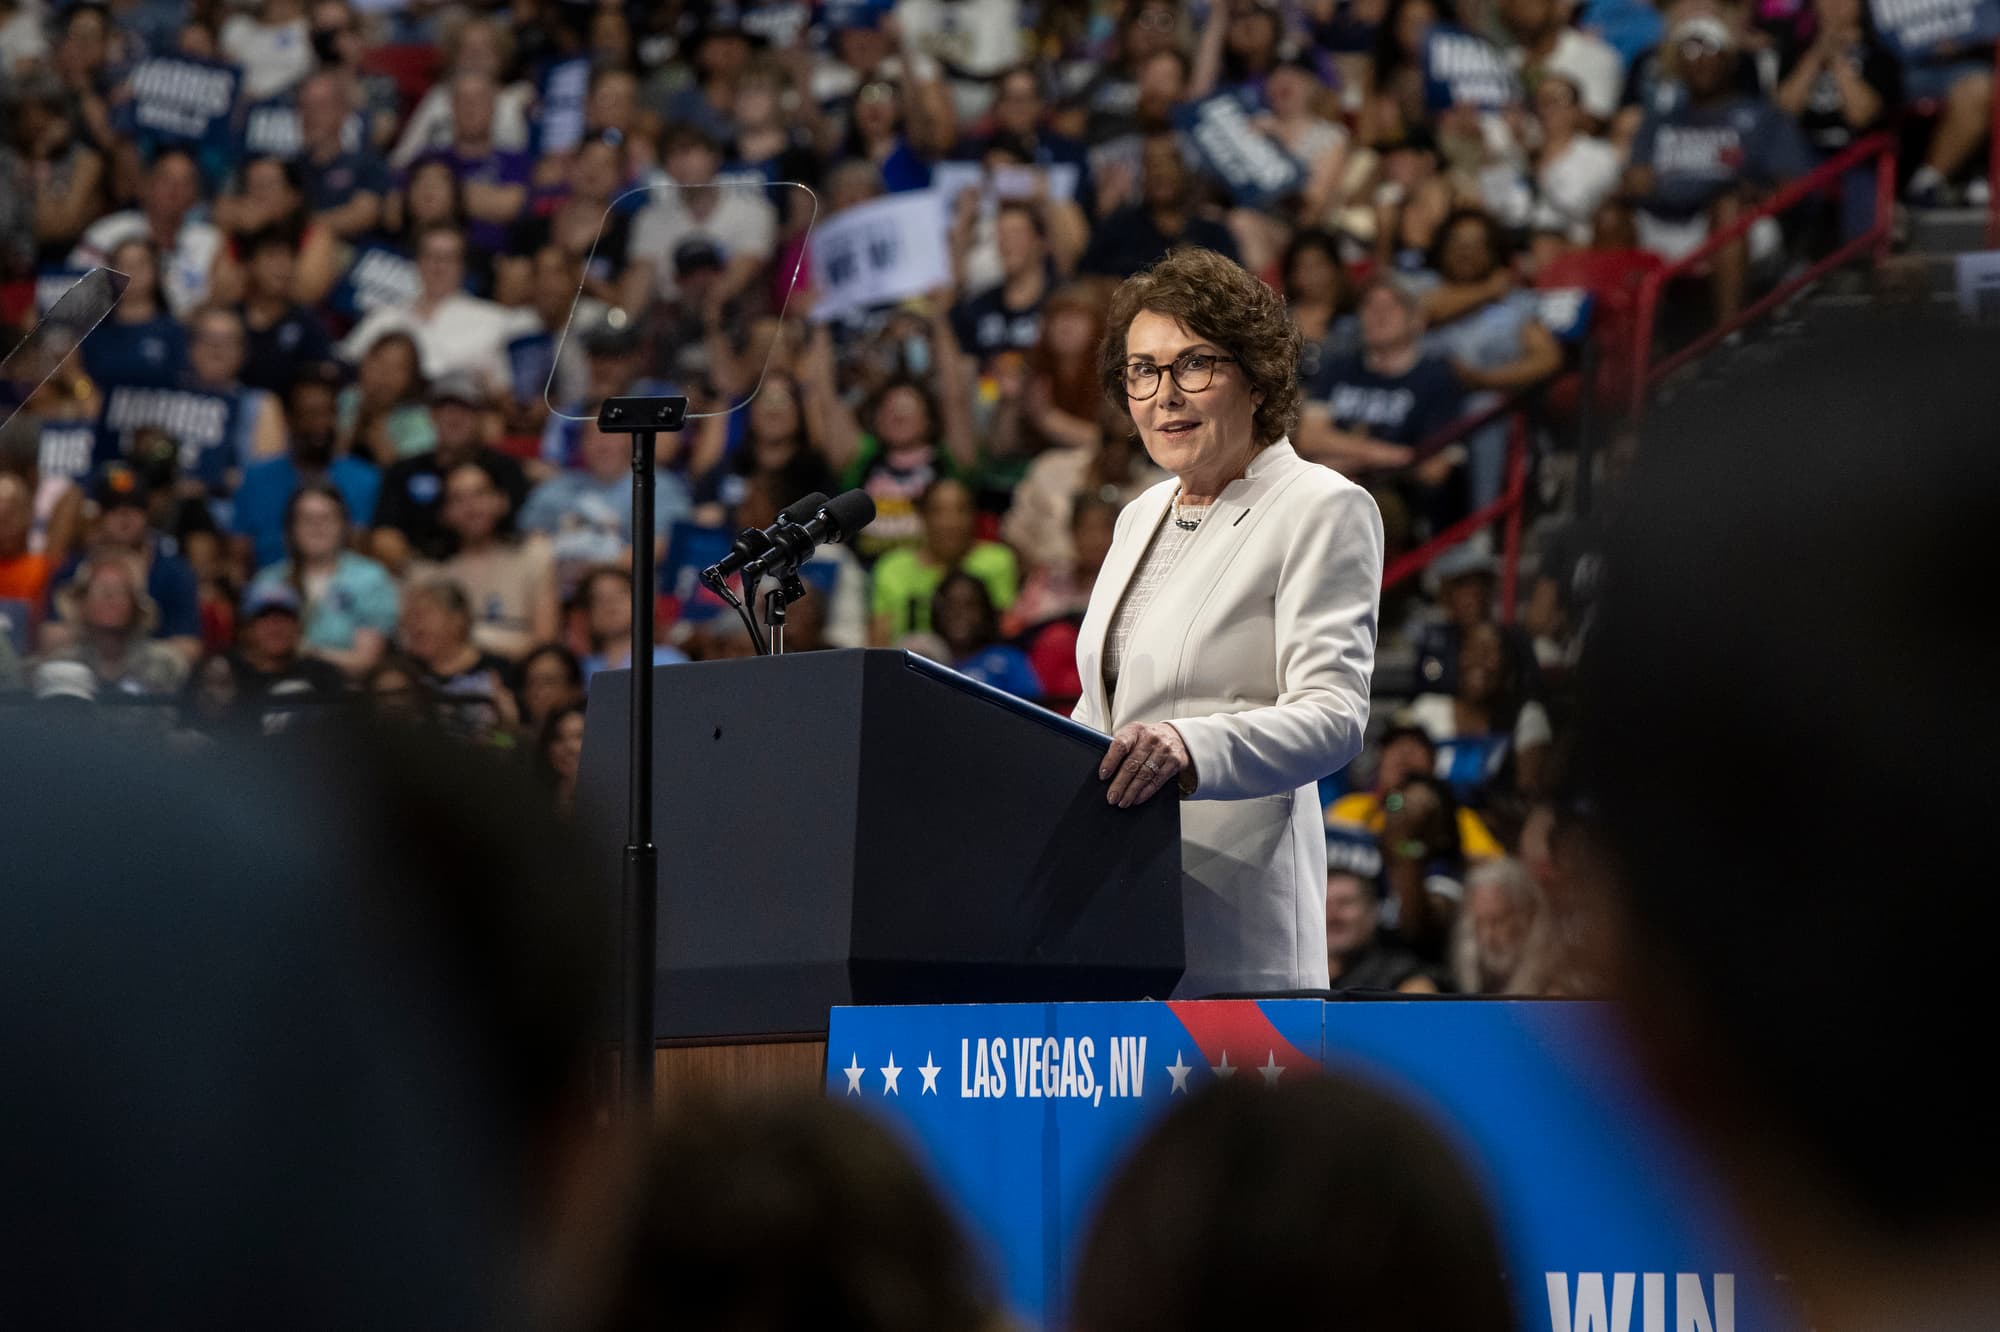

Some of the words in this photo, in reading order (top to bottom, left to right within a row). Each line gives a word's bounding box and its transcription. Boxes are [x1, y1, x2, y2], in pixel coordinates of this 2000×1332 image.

[961, 1037, 1007, 1098] LAS
[1013, 1036, 1103, 1107] VEGAS,
[1110, 1036, 1147, 1097] NV
[1545, 1272, 1735, 1332] WIN
